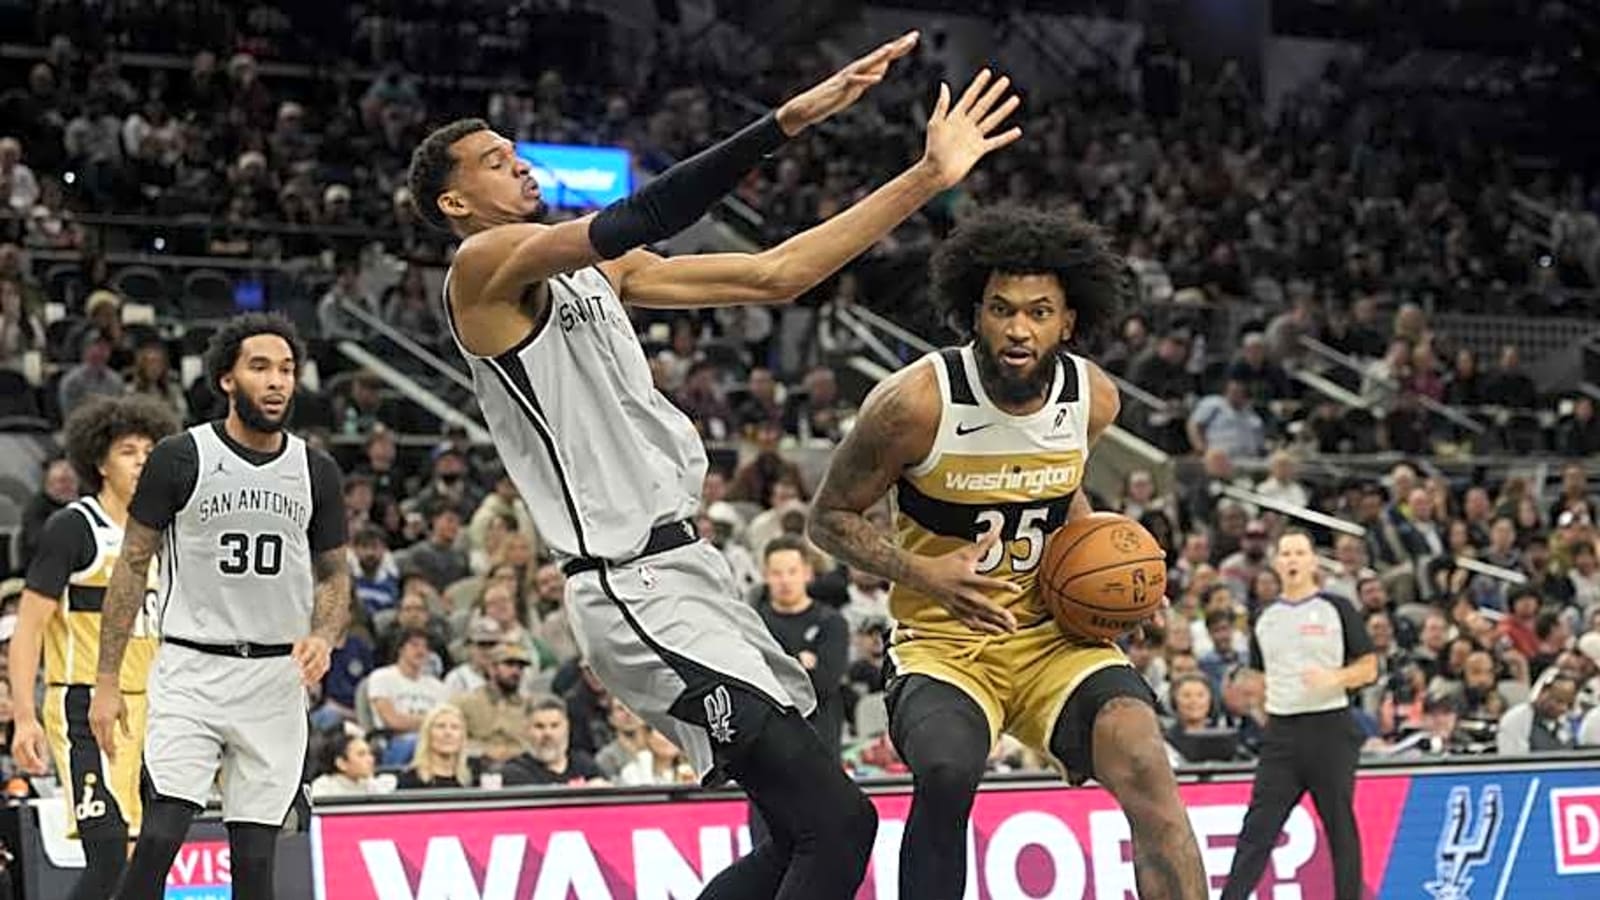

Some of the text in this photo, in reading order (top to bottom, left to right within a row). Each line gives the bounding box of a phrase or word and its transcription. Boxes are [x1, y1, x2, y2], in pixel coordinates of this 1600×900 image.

[945, 464, 1076, 495] washington
[199, 488, 306, 529] SAN ANTONIO
[217, 530, 284, 577] 30
[973, 506, 1050, 575] 35
[166, 848, 232, 885] VIS
